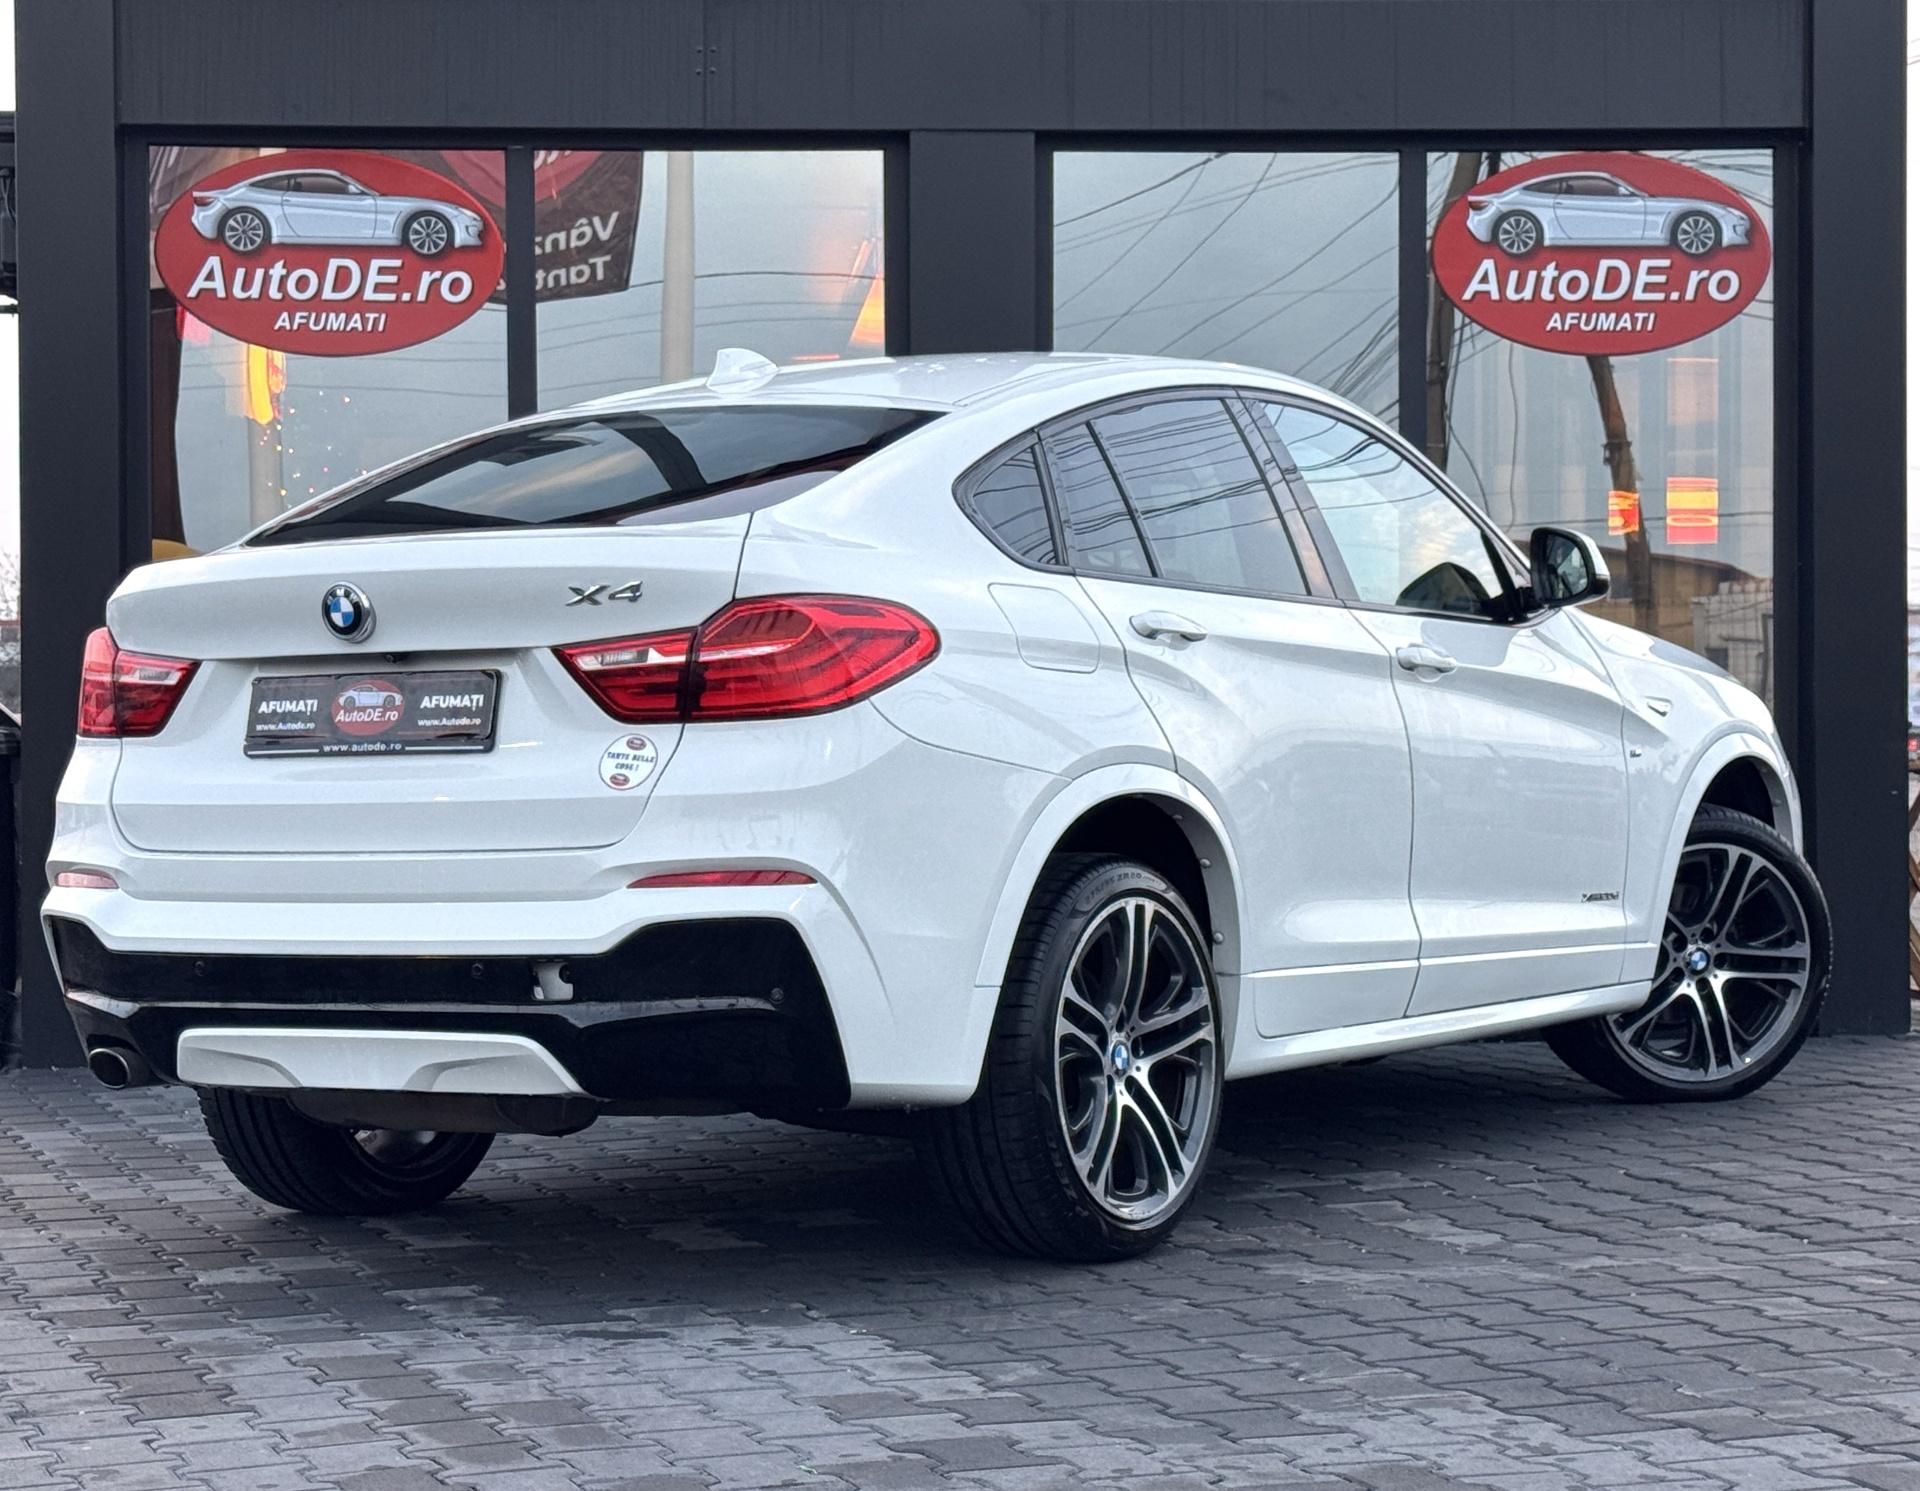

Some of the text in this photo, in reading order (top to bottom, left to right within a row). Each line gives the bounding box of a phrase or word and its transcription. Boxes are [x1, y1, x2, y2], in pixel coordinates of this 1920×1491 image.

[187, 255, 474, 303] AutoDE.ro
[1461, 258, 1740, 302] AutoDE.ro
[274, 311, 387, 332] AFUMATI
[1546, 311, 1656, 332] AFUMATI
[565, 580, 643, 607] X4
[335, 708, 399, 722] AutoDE.ro
[323, 742, 402, 752] www.autode.ro
